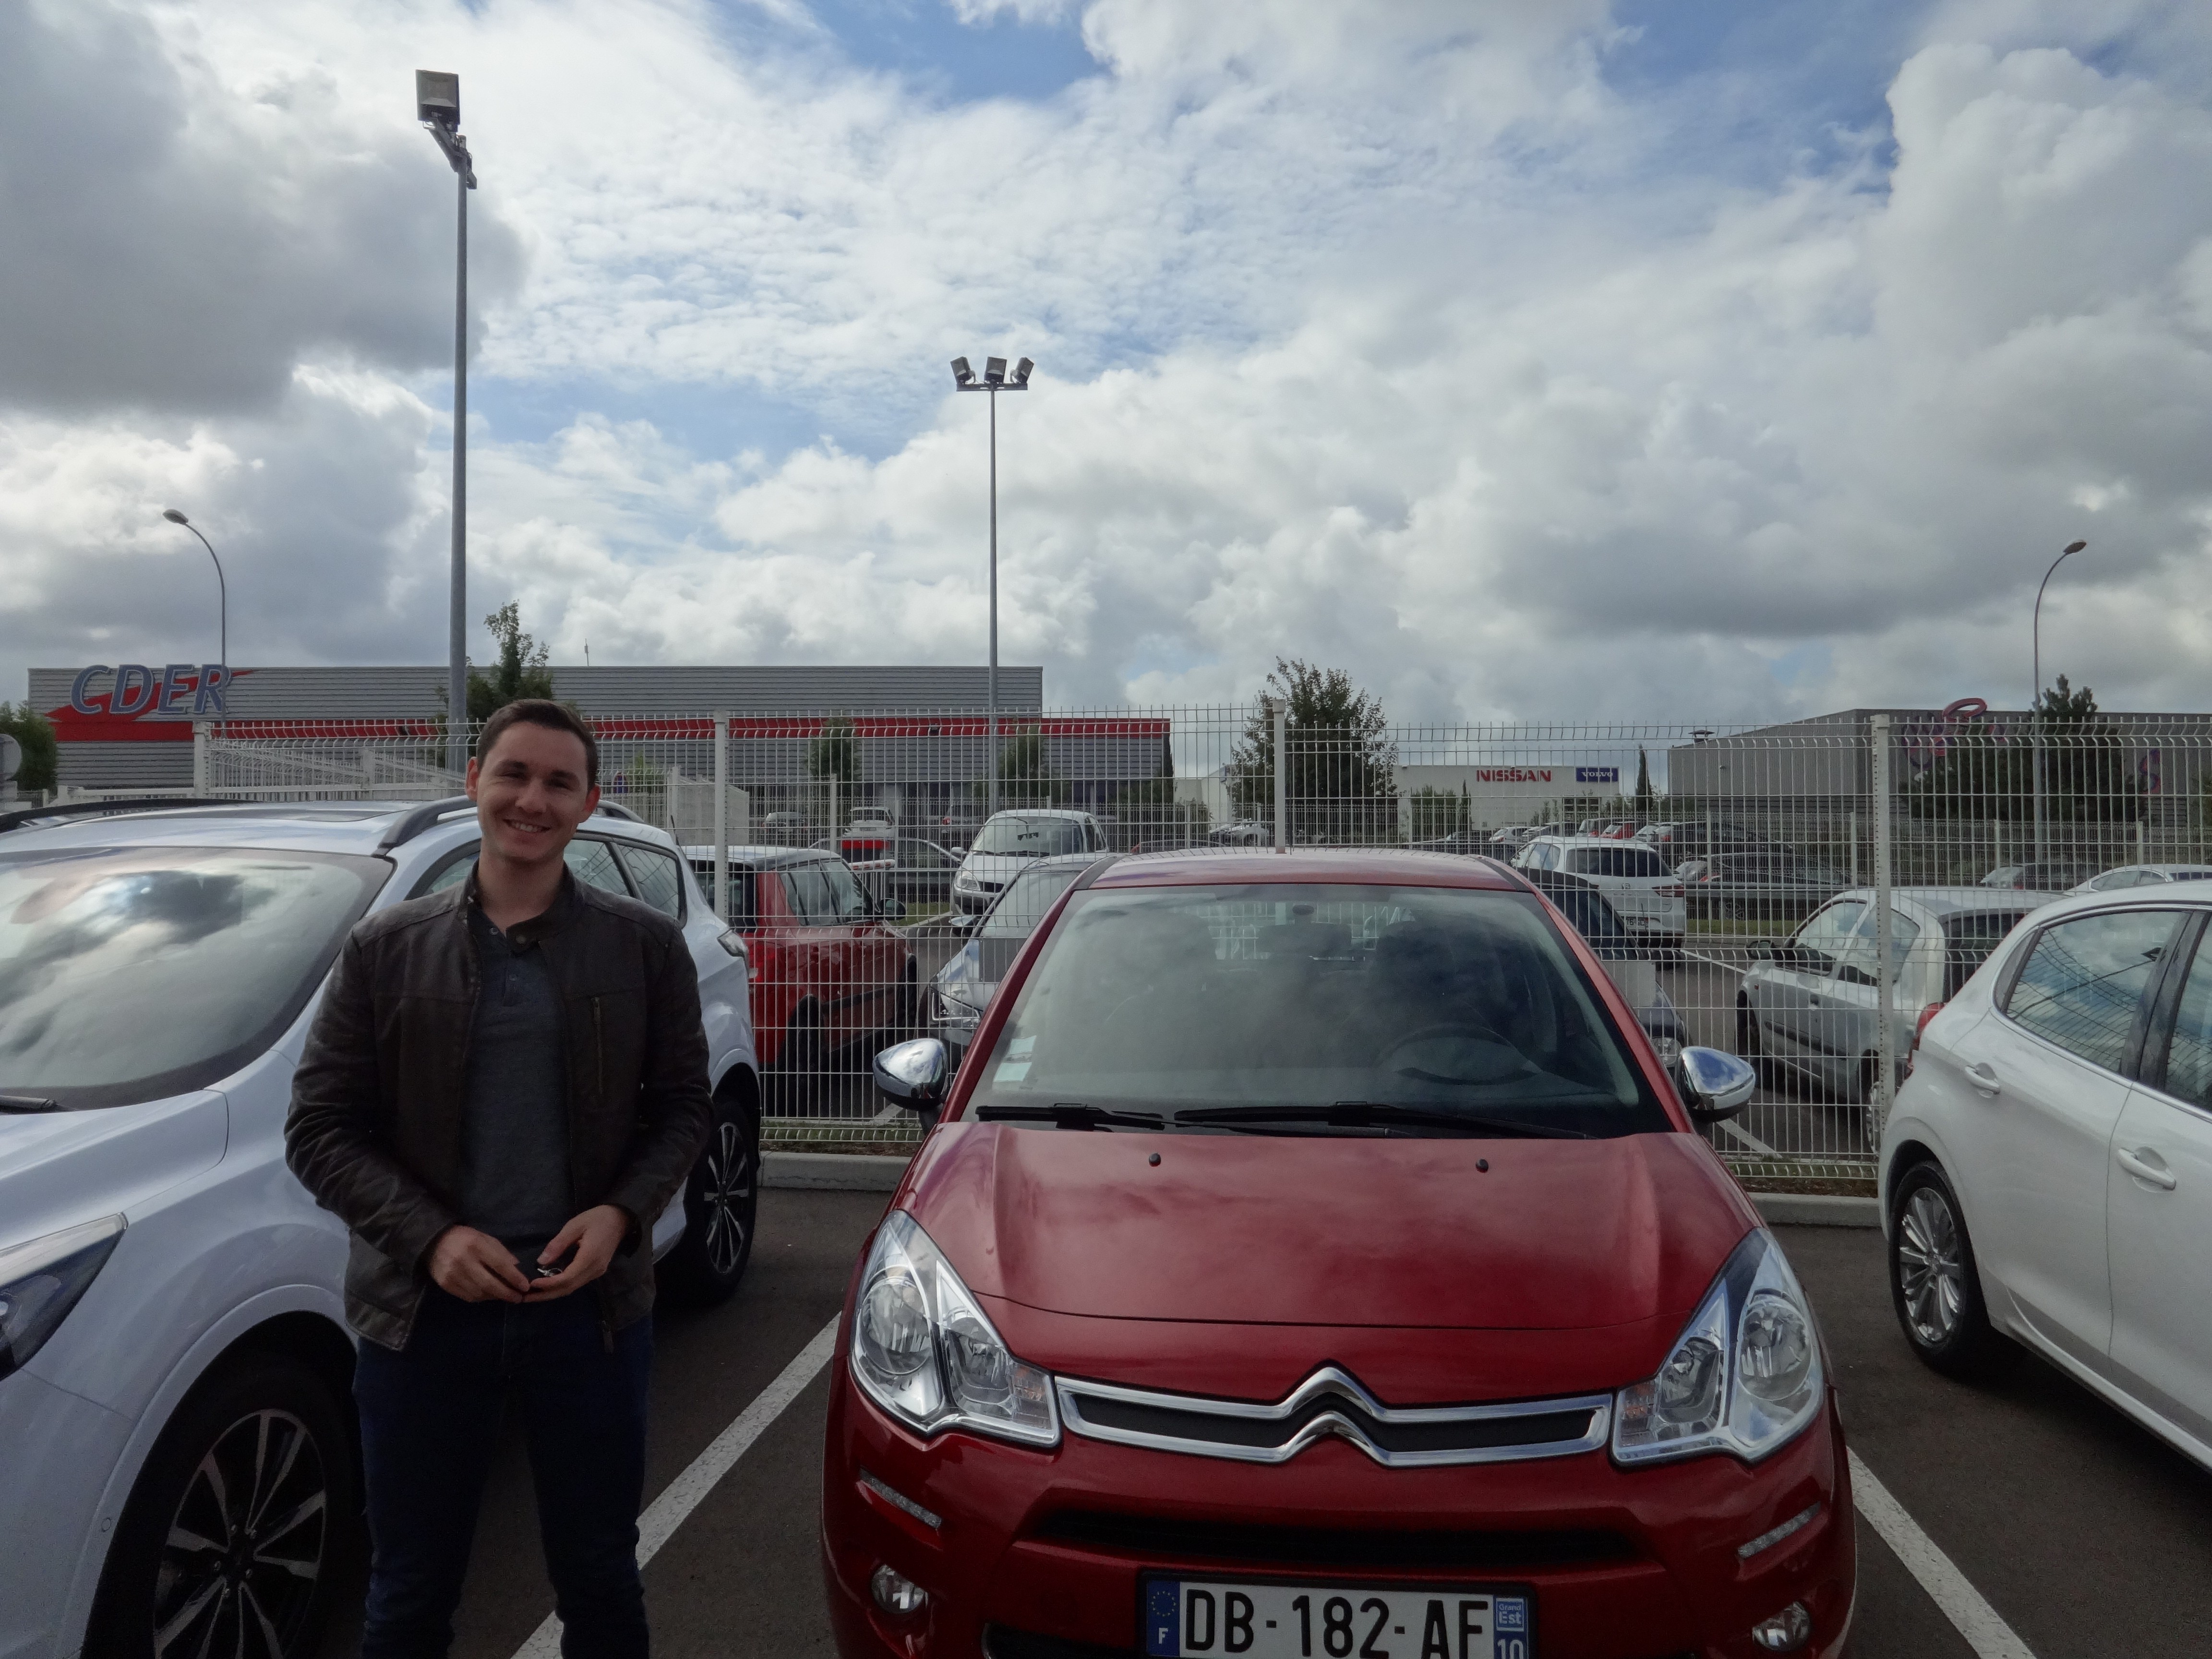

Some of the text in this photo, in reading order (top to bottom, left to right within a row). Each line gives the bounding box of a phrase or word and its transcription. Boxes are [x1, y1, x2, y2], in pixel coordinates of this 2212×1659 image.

[71, 664, 232, 714] CDER
[1476, 769, 1552, 782] NISSAN
[1186, 1589, 1488, 1659] DB-182-AF
[1499, 1611, 1522, 1624] Est
[1158, 1627, 1168, 1644] F
[1497, 1638, 1524, 1659] 10
